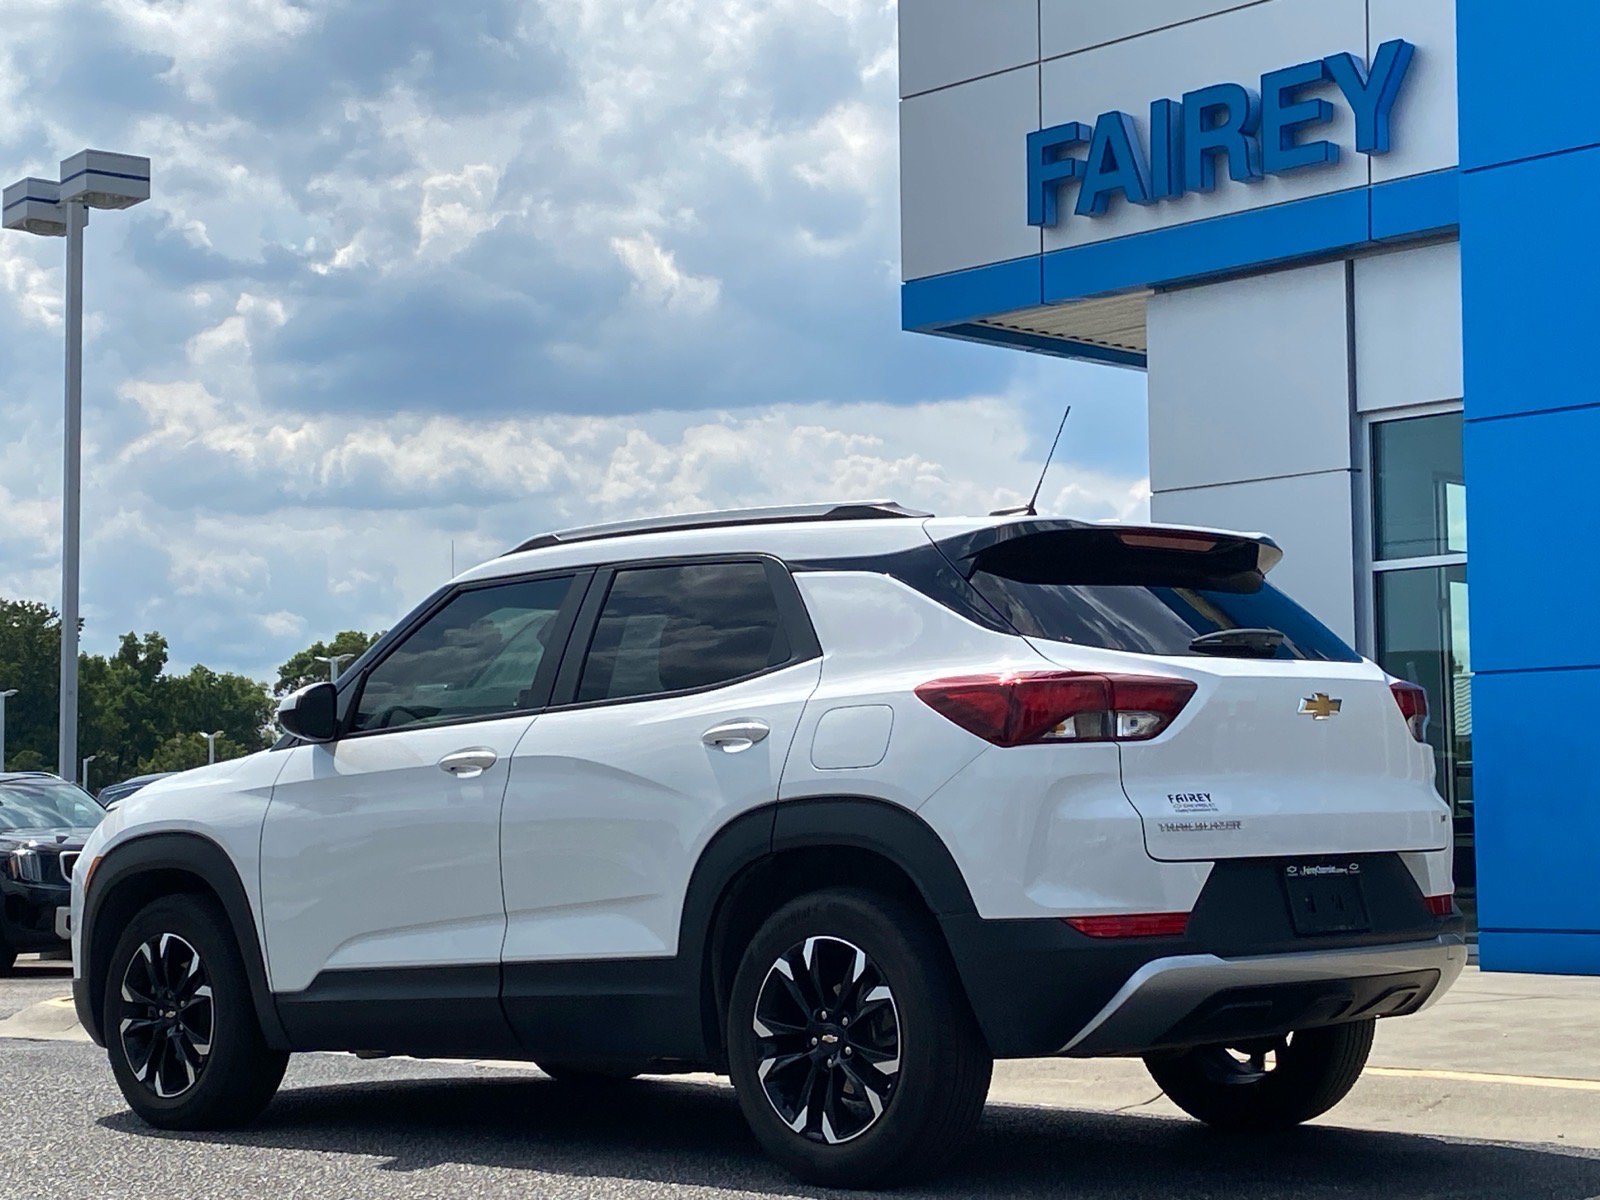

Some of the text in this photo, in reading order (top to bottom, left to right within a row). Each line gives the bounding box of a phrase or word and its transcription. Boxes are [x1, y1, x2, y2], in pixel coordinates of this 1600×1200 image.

[1026, 39, 1416, 227] FAIREY
[1167, 793, 1212, 804] FAIREY
[1158, 820, 1242, 832] TRAILBLAZER
